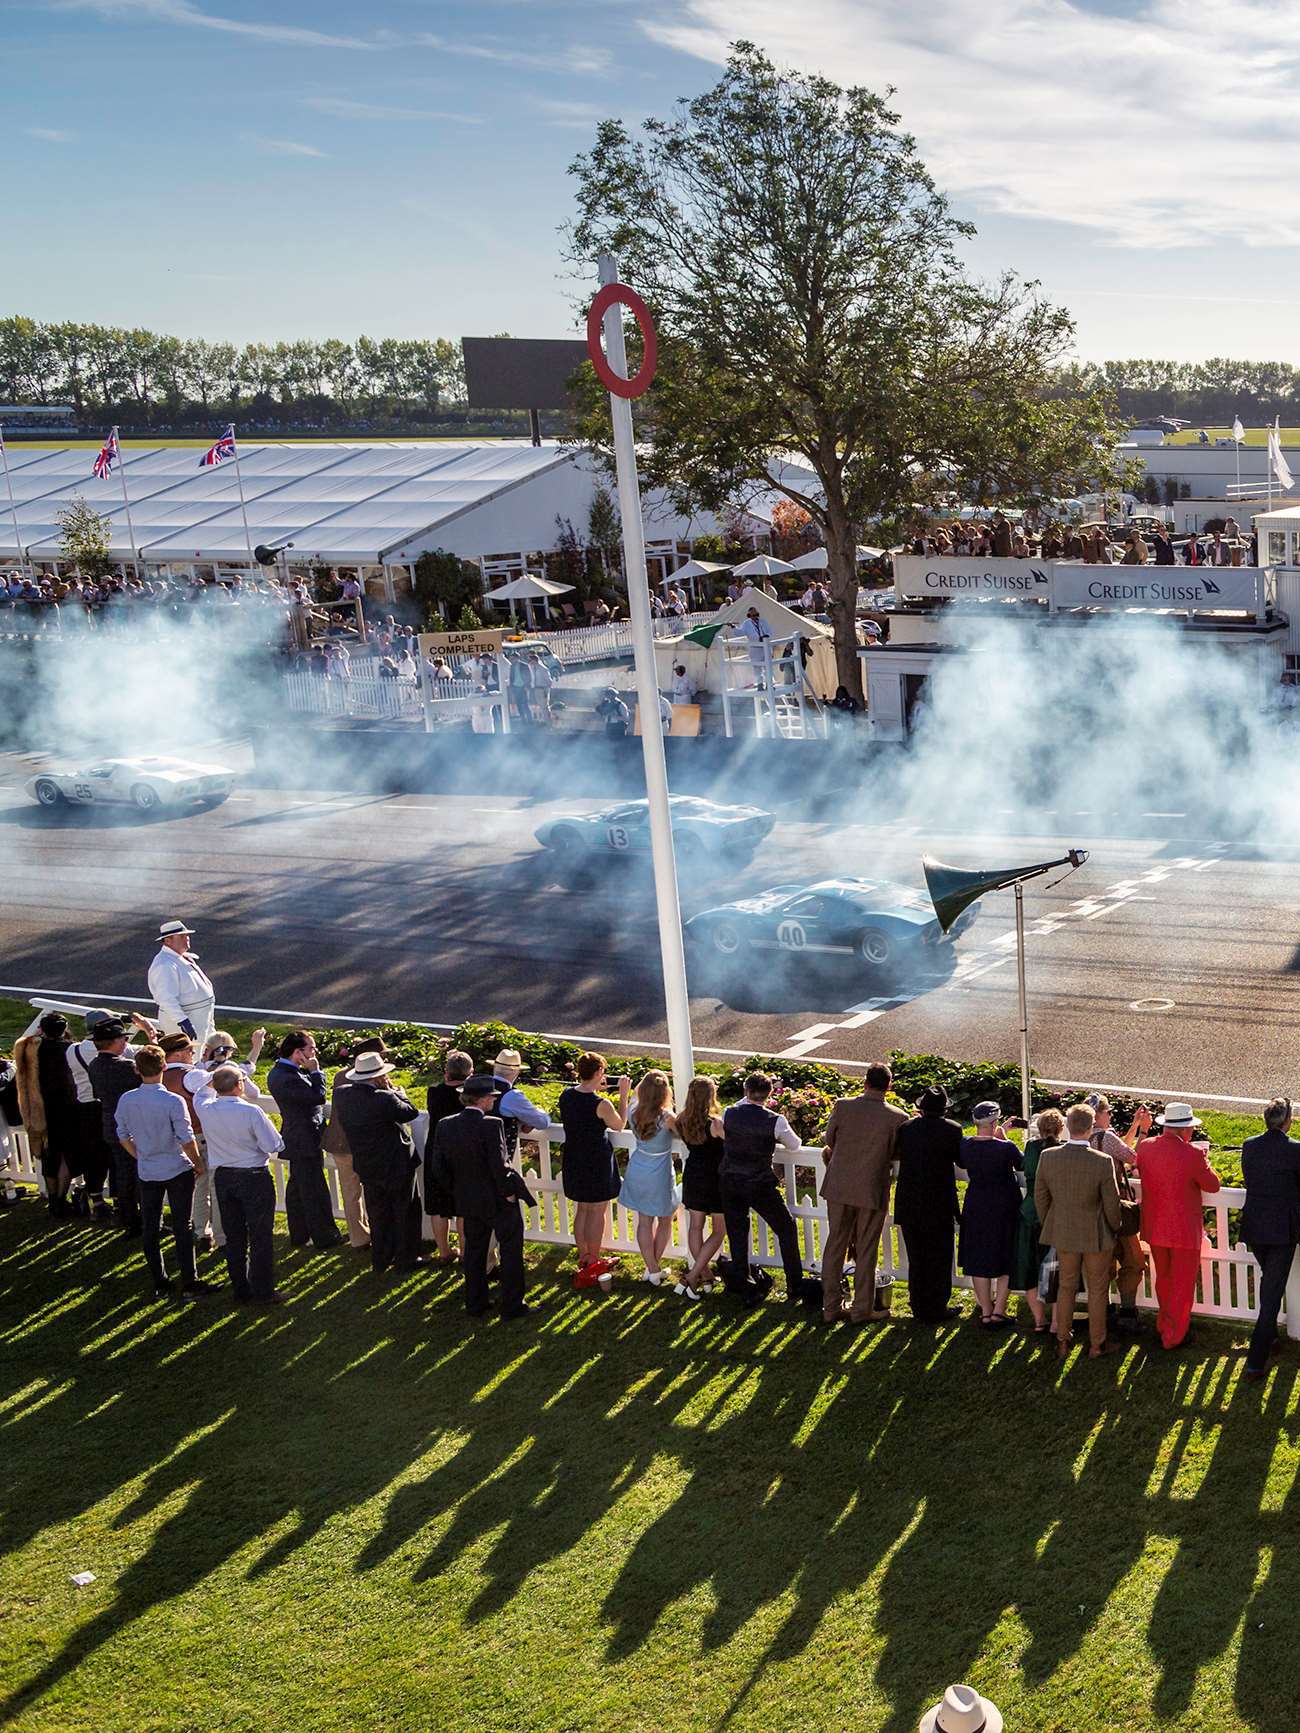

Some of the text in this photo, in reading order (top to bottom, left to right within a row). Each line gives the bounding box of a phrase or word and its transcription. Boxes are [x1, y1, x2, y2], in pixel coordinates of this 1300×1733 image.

[925, 572, 1032, 590] CREDIT SUISSE
[1088, 581, 1203, 600] CREDIT SUISSE
[448, 634, 475, 643] LAPS
[429, 643, 495, 655] COMPLETED
[74, 784, 93, 799] 25
[609, 829, 628, 846] 13
[781, 927, 804, 946] 40
